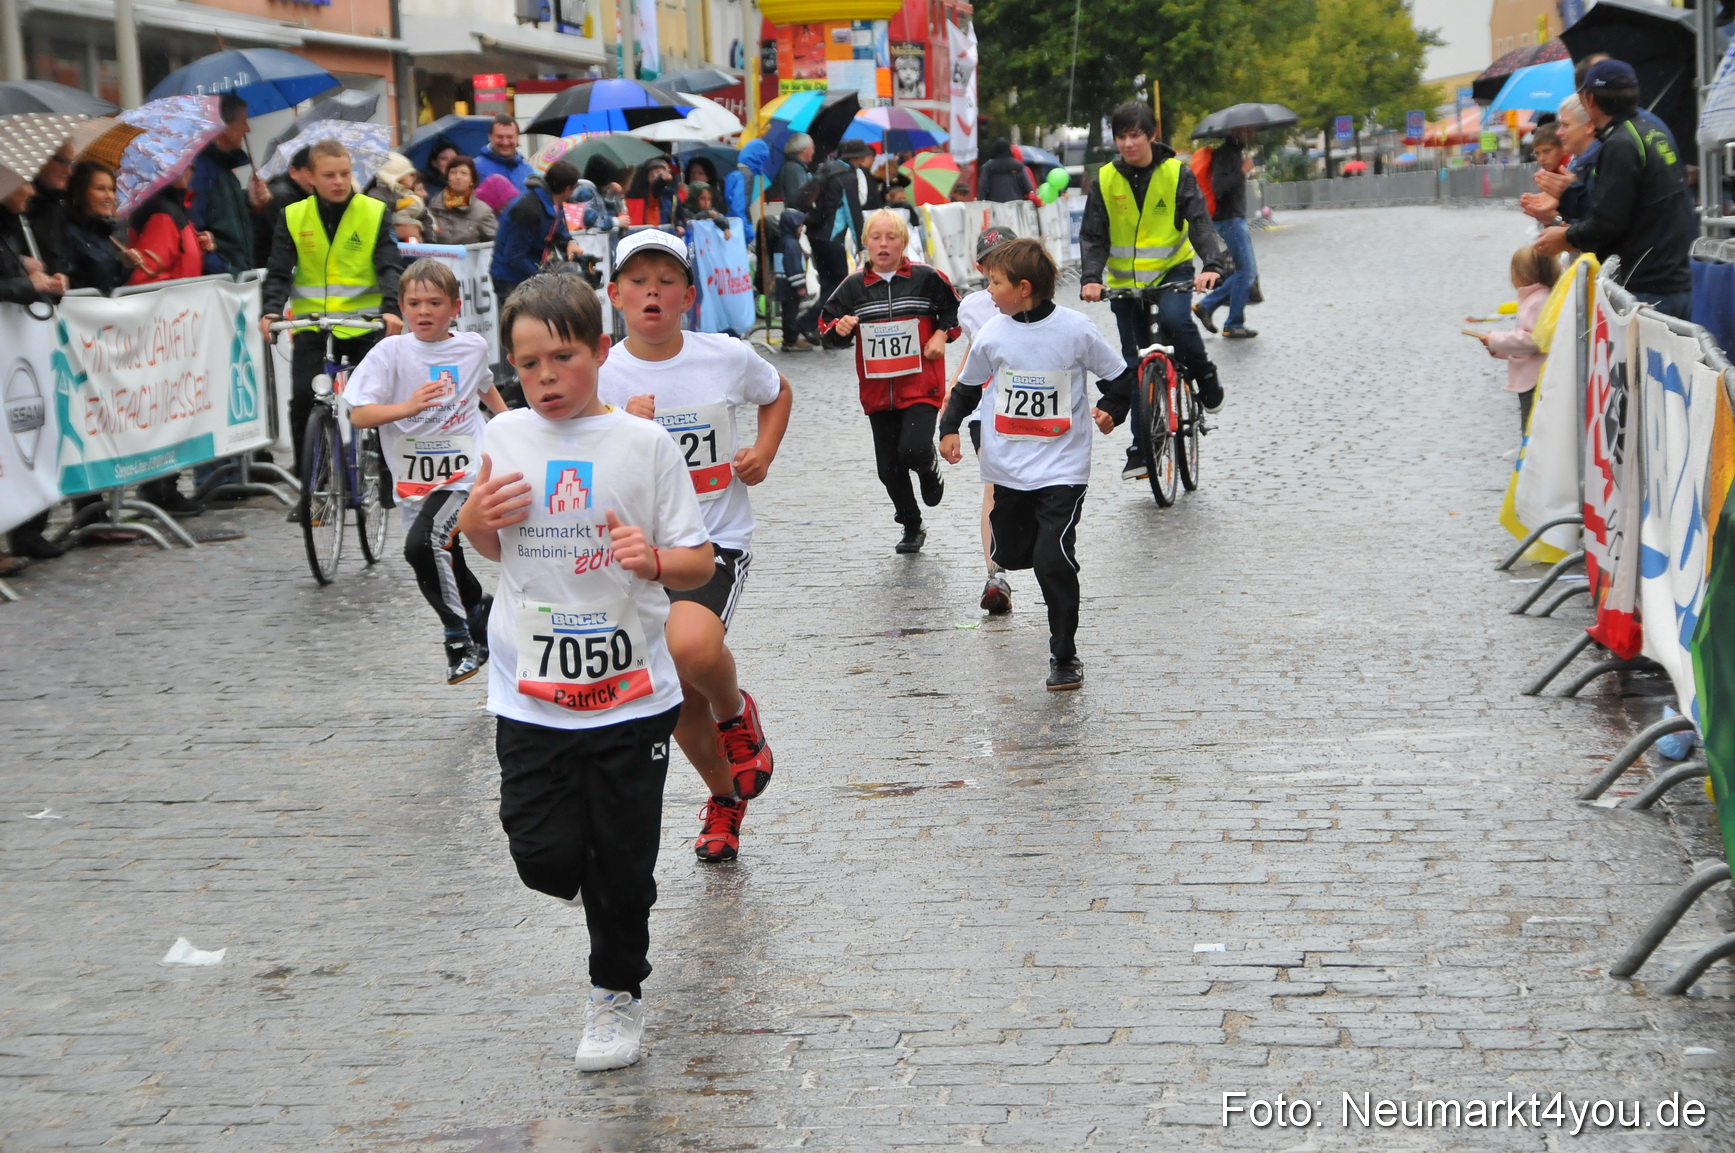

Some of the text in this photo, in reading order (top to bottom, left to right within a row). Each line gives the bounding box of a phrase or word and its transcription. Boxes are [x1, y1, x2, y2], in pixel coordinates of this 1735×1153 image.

[867, 335, 912, 358] 7187
[230, 363, 257, 421] GS
[1012, 375, 1046, 385] BOCK
[85, 382, 158, 436] EINFACH
[1004, 388, 1059, 418] 7281
[415, 440, 451, 450] BOCK
[673, 429, 717, 467] 21
[402, 454, 470, 482] 7049
[519, 523, 610, 538] neumarkt T
[517, 544, 605, 559] Bambini-Lauf
[551, 612, 607, 627] BOCK
[532, 628, 633, 680] 7050
[636, 658, 644, 667] M
[553, 683, 620, 709] Patrick
